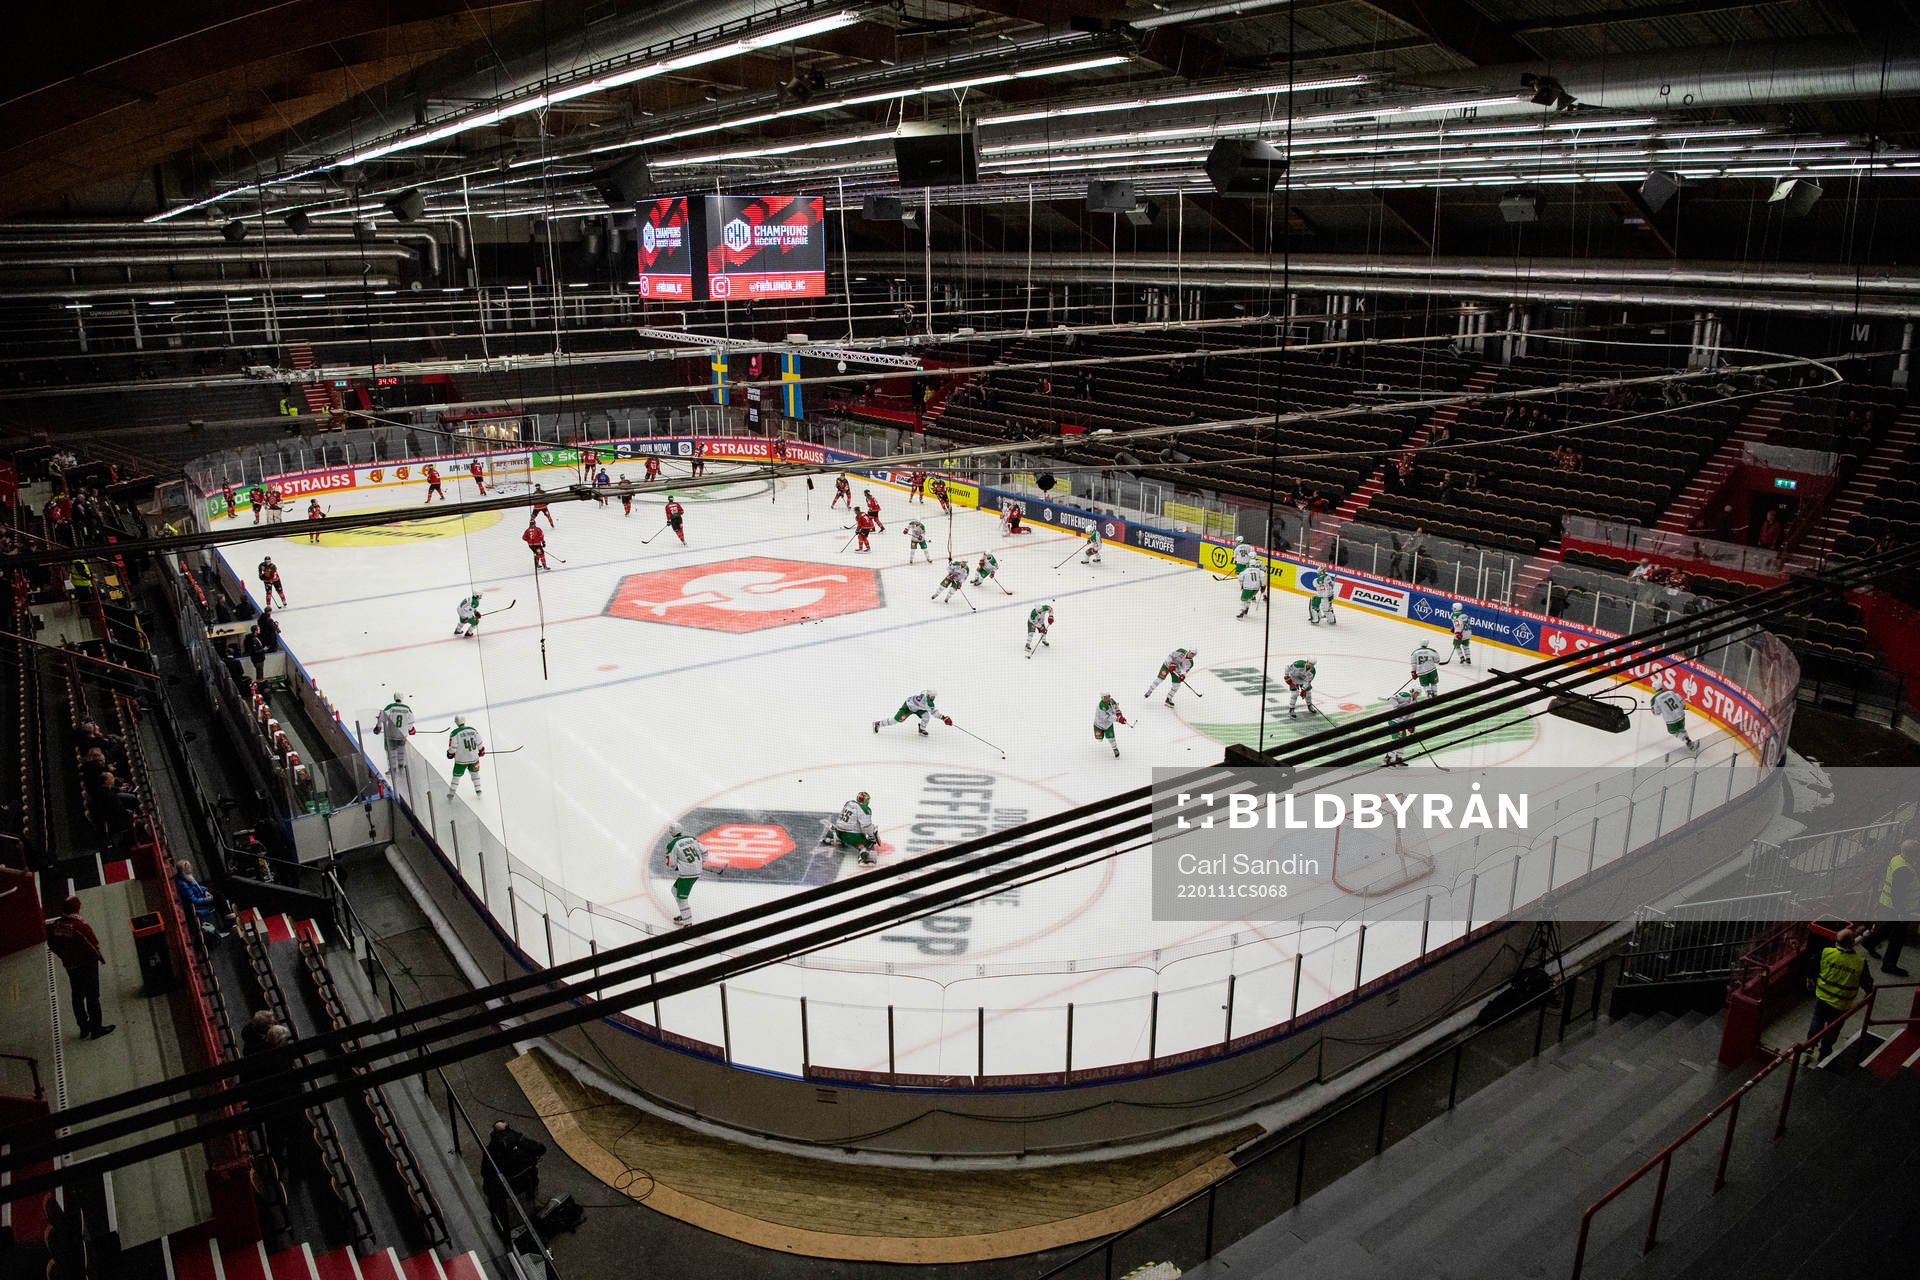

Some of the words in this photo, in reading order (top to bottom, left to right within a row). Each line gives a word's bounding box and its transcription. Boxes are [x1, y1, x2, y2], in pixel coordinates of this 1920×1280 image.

[754, 225, 808, 237] CHAMPIONS
[754, 237, 781, 246] HOCKEY
[783, 237, 808, 246] LEAGUE
[1356, 298, 1365, 311] K
[1850, 323, 1870, 342] M
[639, 444, 652, 453] JOIN
[654, 443, 671, 452] NOW!
[712, 443, 767, 455] STRAUSS
[786, 447, 824, 464] STRAUSS
[283, 473, 350, 494] STRAUSS
[1144, 537, 1175, 553] PLAYOFFS
[1363, 572, 1384, 582] STRAUSS
[1392, 579, 1414, 590] STRAUSS
[1423, 586, 1446, 597] STRAUSS
[1354, 590, 1400, 607] RADIAL
[1454, 594, 1478, 605] STRAUSS
[1415, 604, 1431, 614] LGT
[1487, 602, 1512, 614] STRAUSS
[1522, 611, 1547, 622] STRAUSS
[1469, 617, 1510, 635] BANKING
[1558, 619, 1584, 631] STRAUSS
[1516, 629, 1531, 640] LGT
[1595, 629, 1621, 639] STRAUS
[1664, 697, 1679, 712] 12
[396, 715, 403, 728] 8
[1702, 686, 1767, 750] STRAUSS
[682, 847, 700, 864] 54
